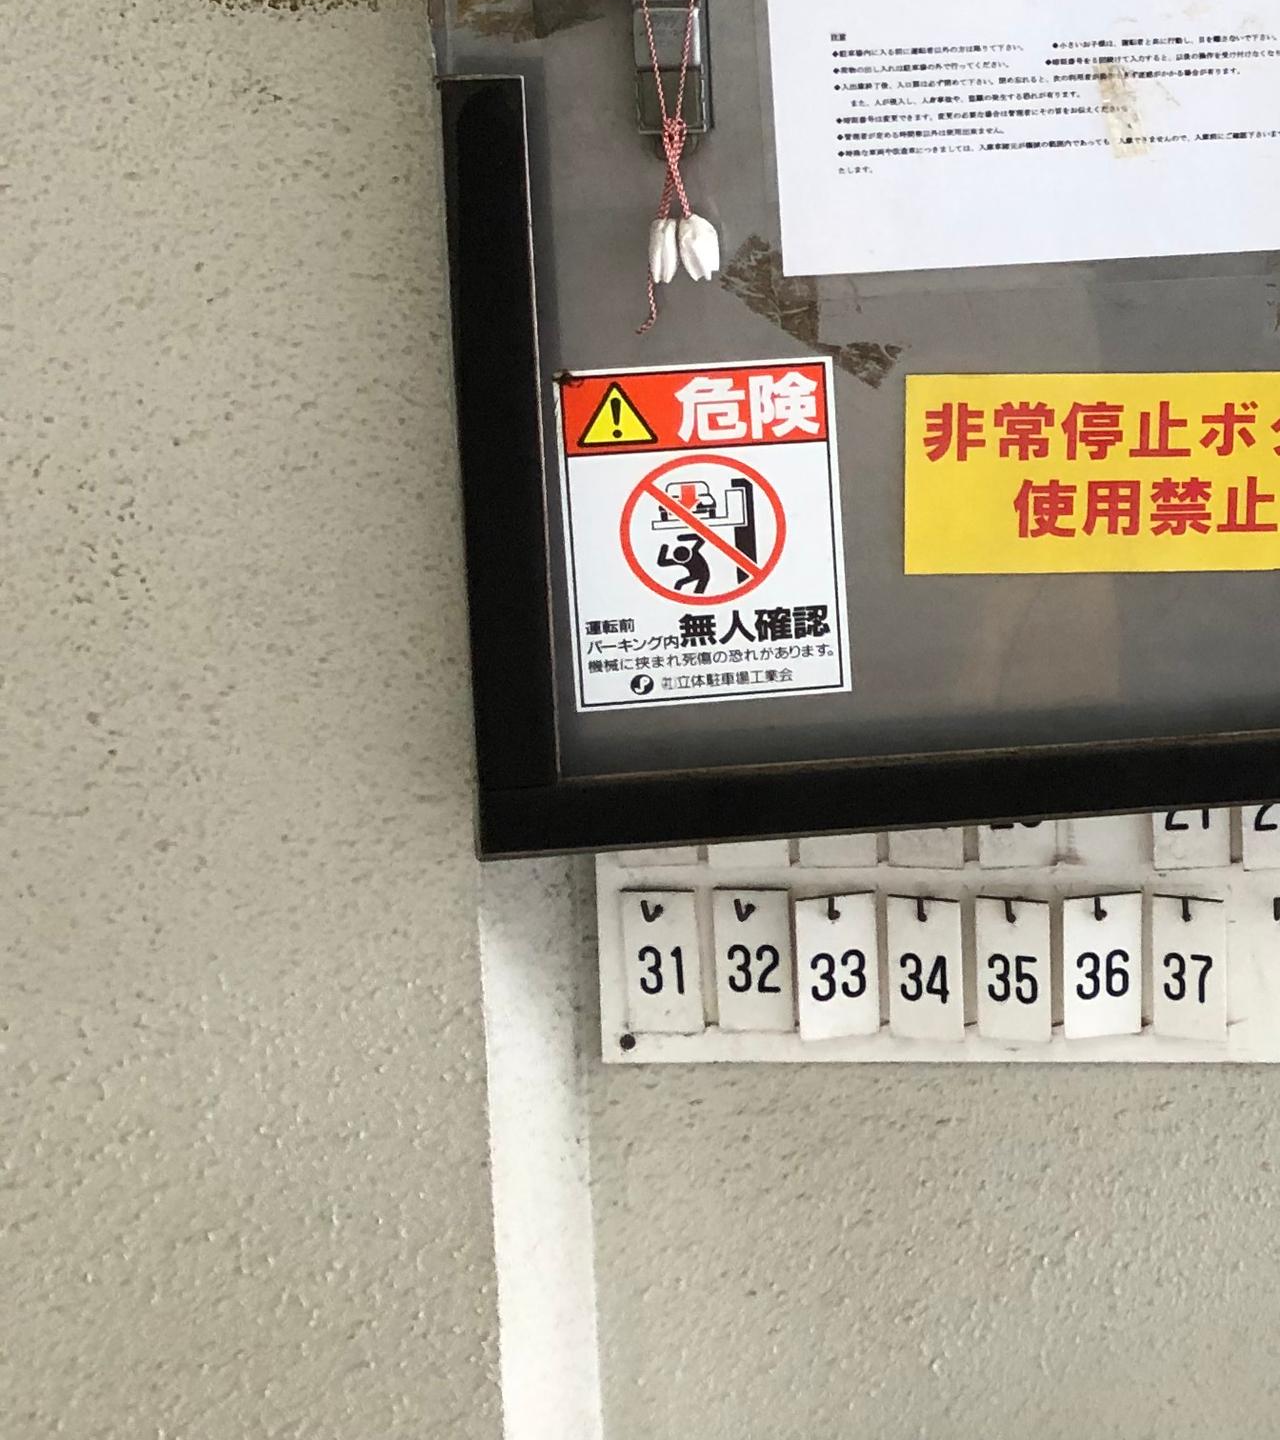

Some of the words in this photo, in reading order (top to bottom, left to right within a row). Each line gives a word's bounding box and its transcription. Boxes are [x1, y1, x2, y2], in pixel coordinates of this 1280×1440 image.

[674, 371, 821, 443] 危険
[1012, 475, 1279, 538] 使用禁止
[584, 617, 636, 636] 運転前
[587, 633, 680, 655] パーキング内
[678, 604, 832, 648] 無人確認
[587, 642, 834, 674] 機械に挟まれ死傷の恐れがあります。
[638, 944, 686, 995] 31
[726, 943, 782, 995] 32
[809, 949, 868, 1003] 33
[898, 953, 951, 1005] 34
[986, 953, 1039, 1005] 35
[1074, 949, 1131, 1000] 36
[1162, 953, 1215, 1005] 37
